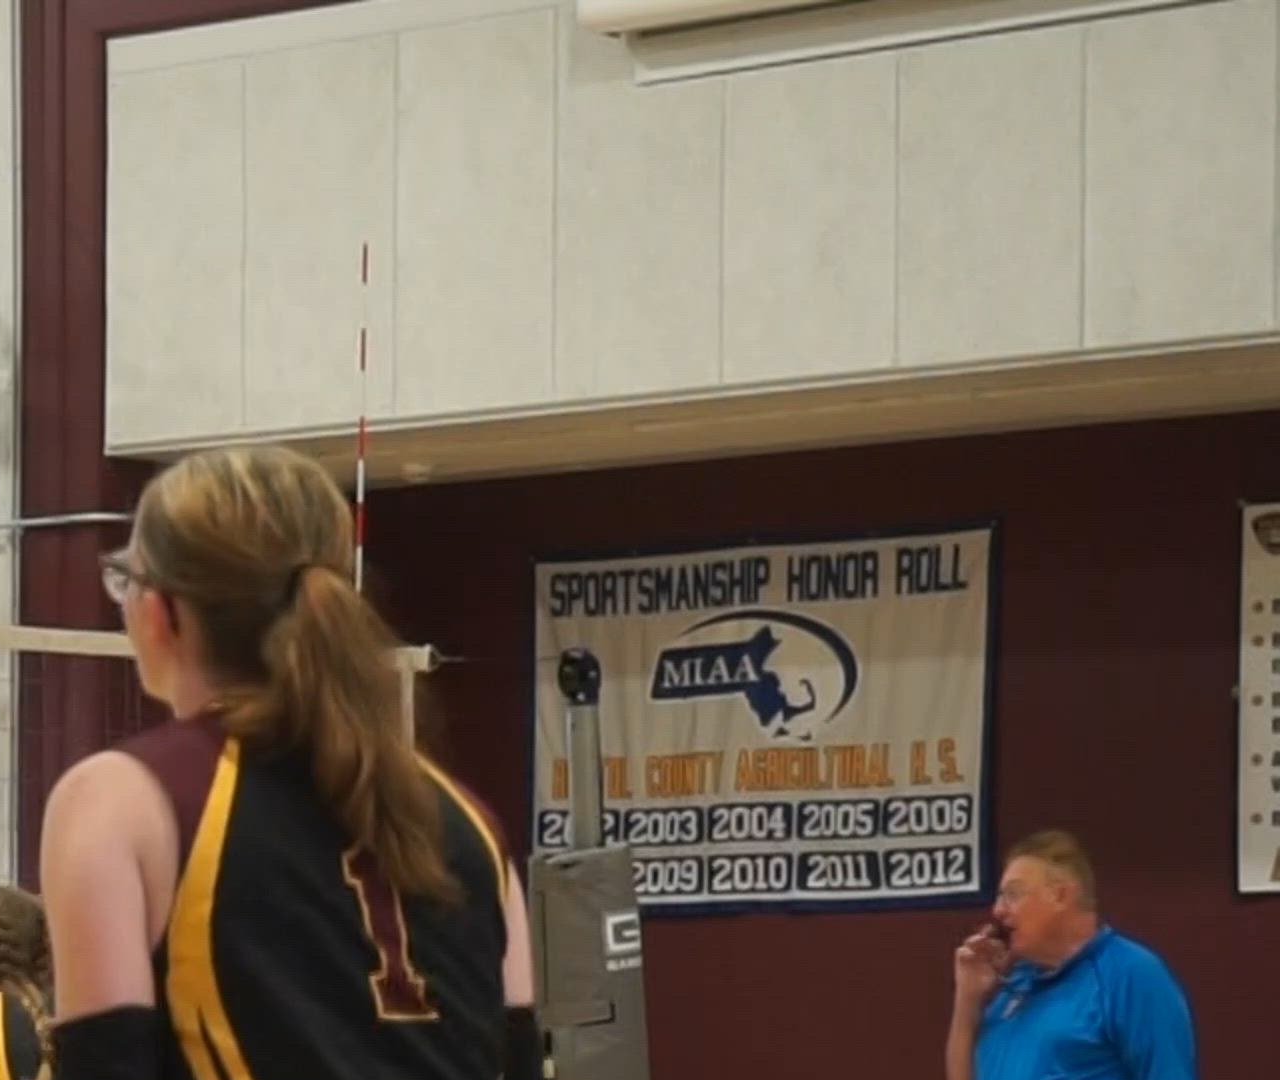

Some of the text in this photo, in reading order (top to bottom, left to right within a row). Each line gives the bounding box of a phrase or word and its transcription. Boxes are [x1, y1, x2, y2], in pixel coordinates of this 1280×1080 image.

[550, 543, 969, 618] SPORTSMANSHIP HONOR ROLL
[661, 655, 761, 689] MIAA
[646, 752, 724, 797] COUNTY
[735, 743, 895, 792] AGRICULTURAL
[628, 811, 697, 844] 2003
[711, 806, 787, 840] 2004
[802, 802, 875, 838] 2005
[890, 799, 970, 834] 2006
[633, 849, 966, 893] 2009 2010 2011 2012
